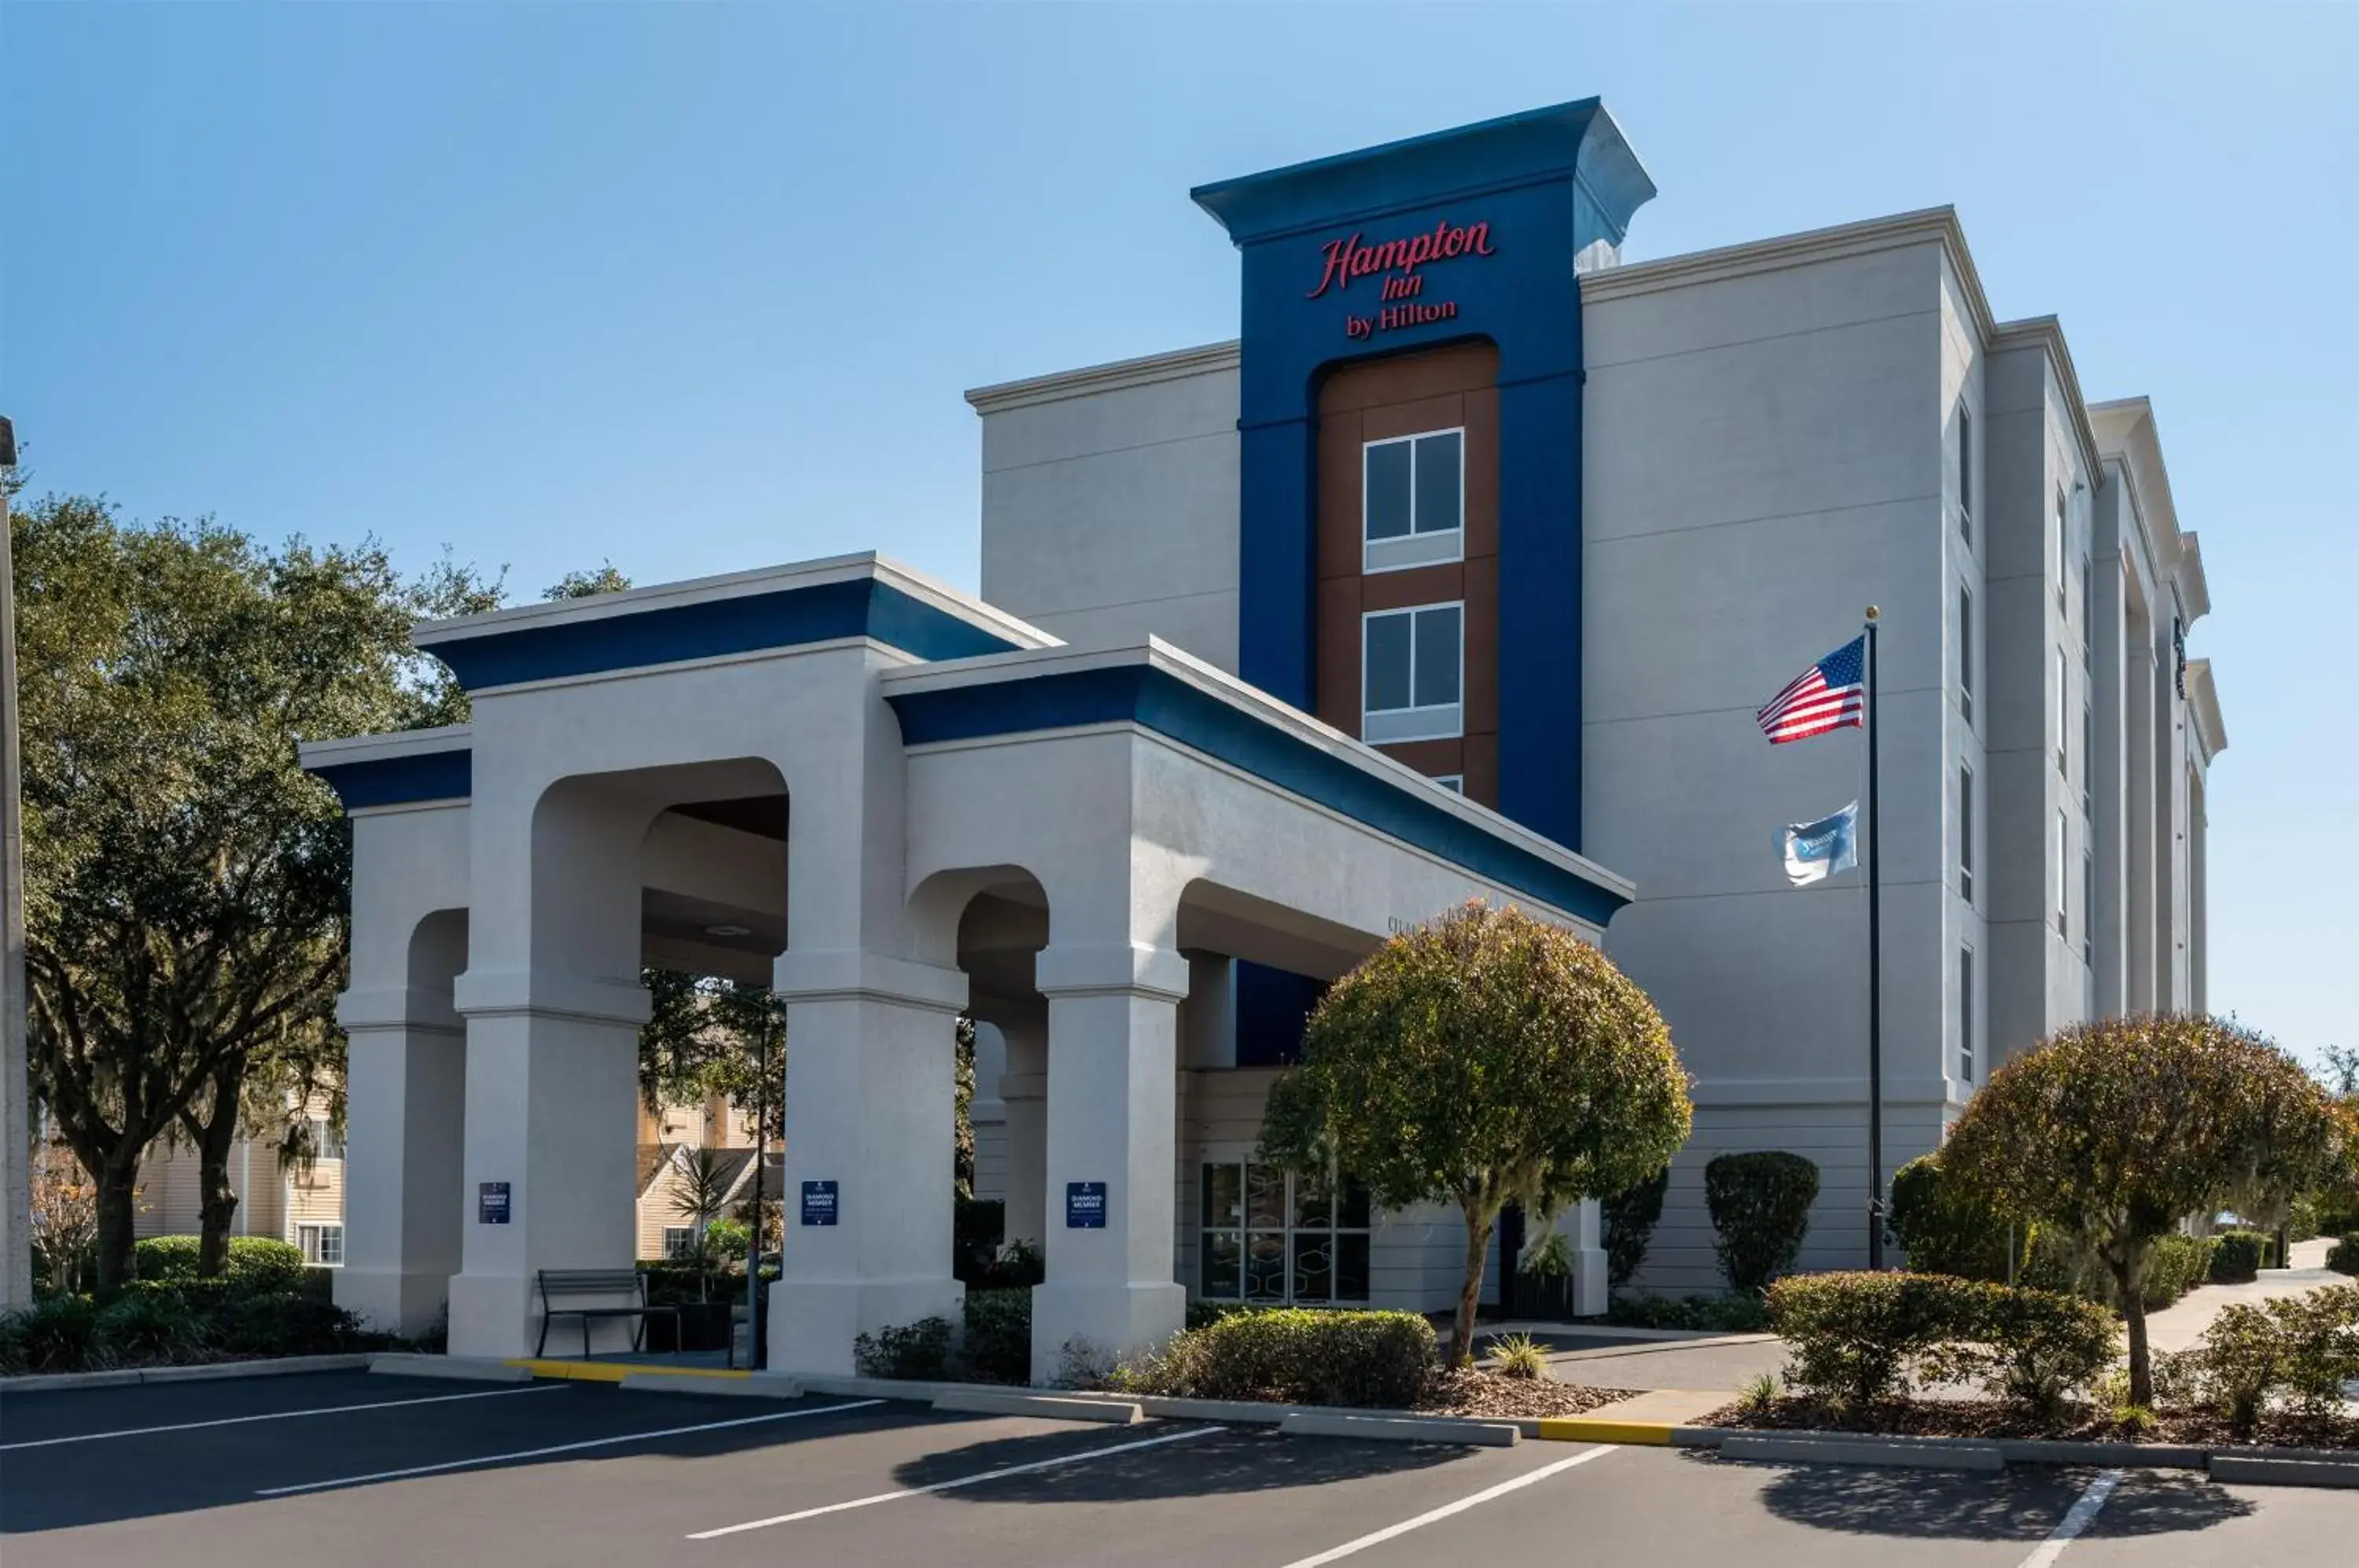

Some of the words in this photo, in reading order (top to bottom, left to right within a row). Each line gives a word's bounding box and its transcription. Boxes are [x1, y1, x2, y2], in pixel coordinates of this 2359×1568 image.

[1305, 220, 1496, 299] Hampton
[1381, 273, 1423, 301] Inn
[1345, 314, 1375, 340] by
[1380, 300, 1457, 331] Hilton
